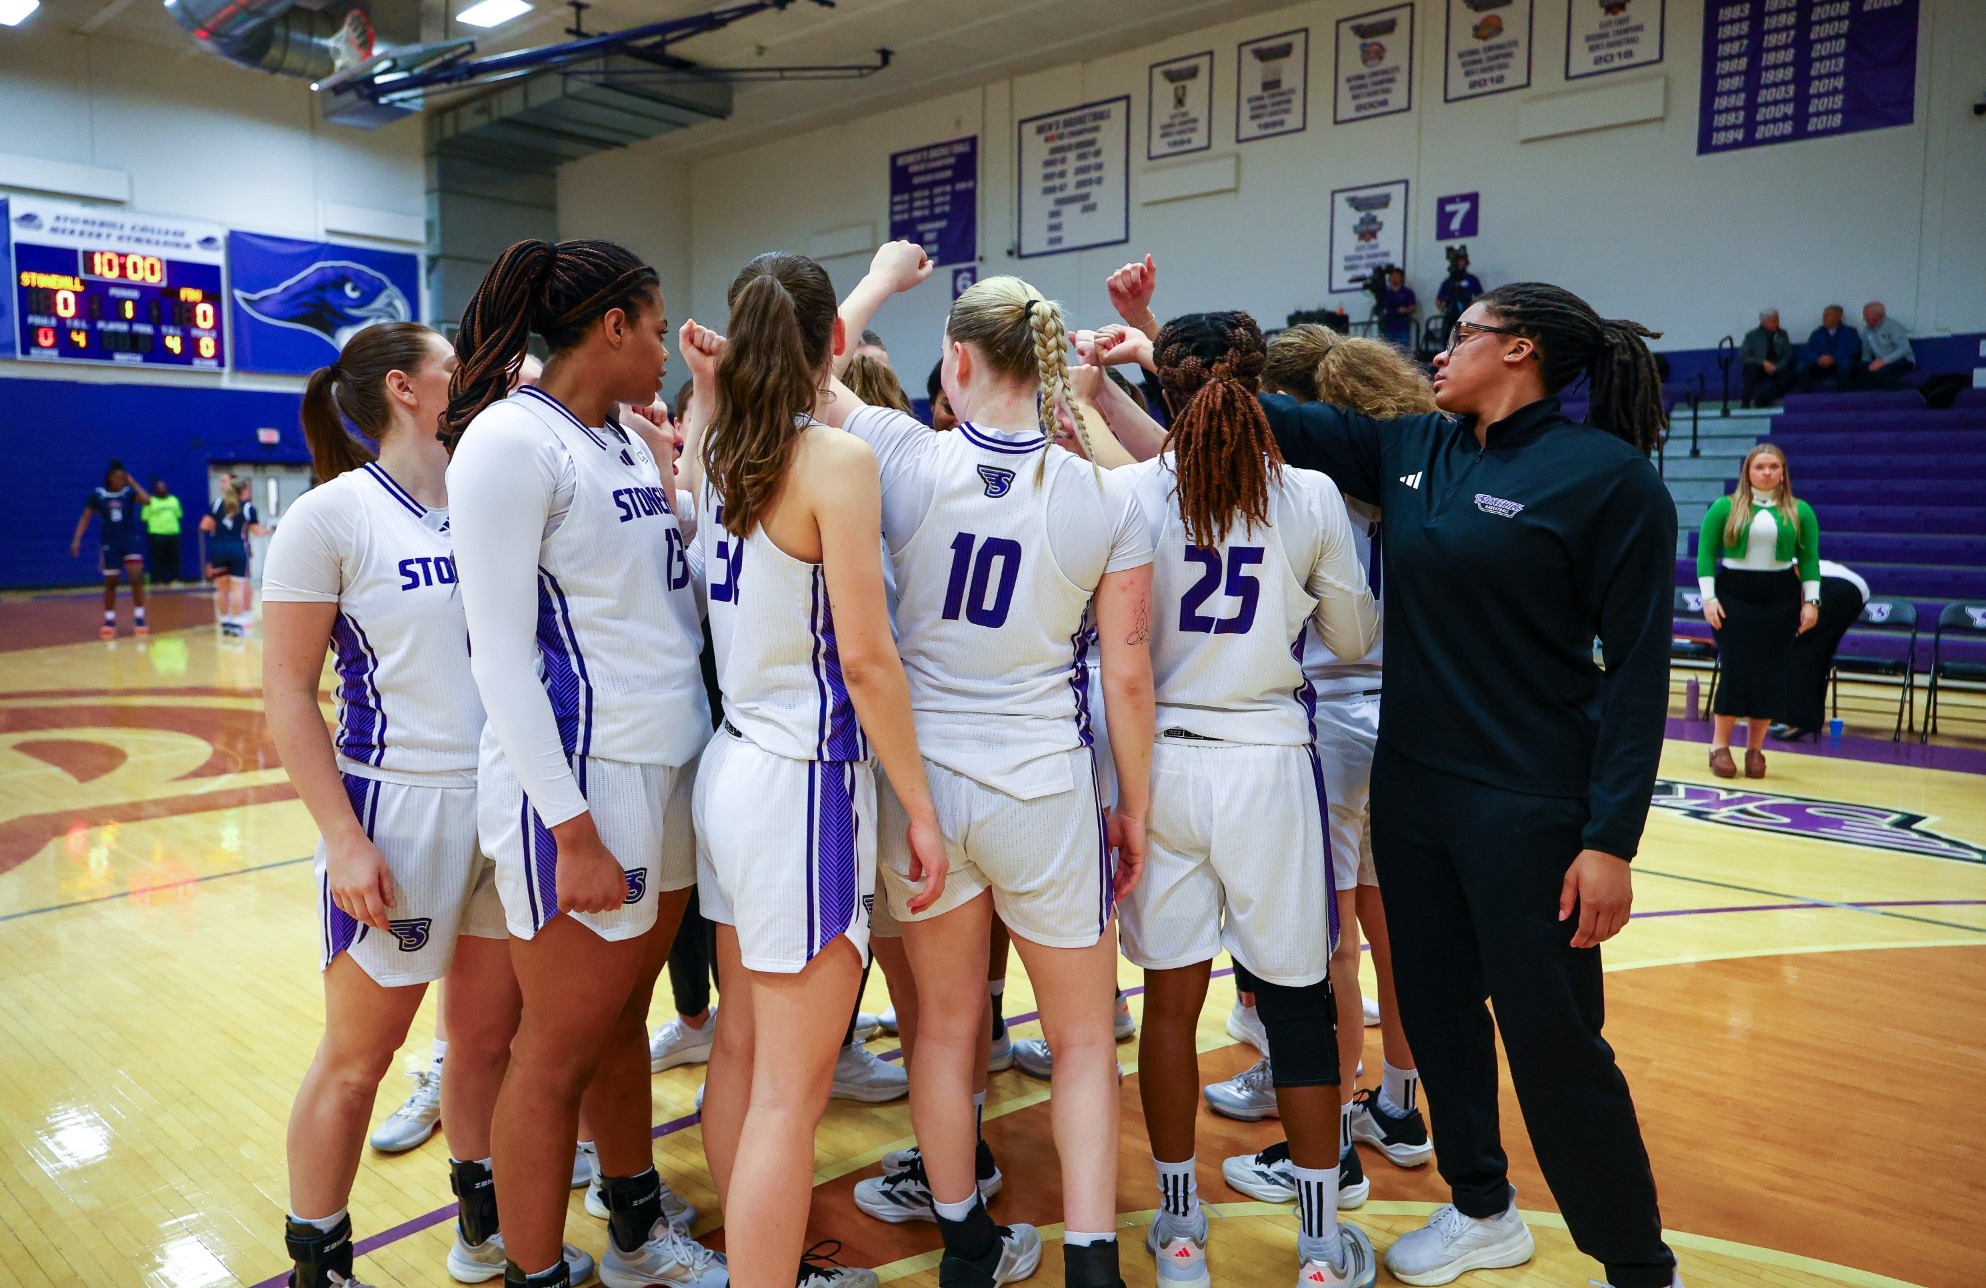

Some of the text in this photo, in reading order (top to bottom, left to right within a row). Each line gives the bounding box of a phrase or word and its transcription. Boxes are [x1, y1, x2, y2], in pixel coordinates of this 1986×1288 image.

[1811, 38, 1846, 58] 2010
[1809, 75, 1845, 95] 2014
[1756, 102, 1794, 121] 2004
[1445, 201, 1471, 231] 7
[93, 251, 162, 284] 10:00
[56, 290, 76, 318] 0
[195, 302, 214, 329] 0
[71, 329, 86, 348] 4
[165, 335, 182, 354] 4
[665, 528, 689, 592] 13
[942, 531, 1022, 629] 10
[1179, 544, 1265, 635] 25
